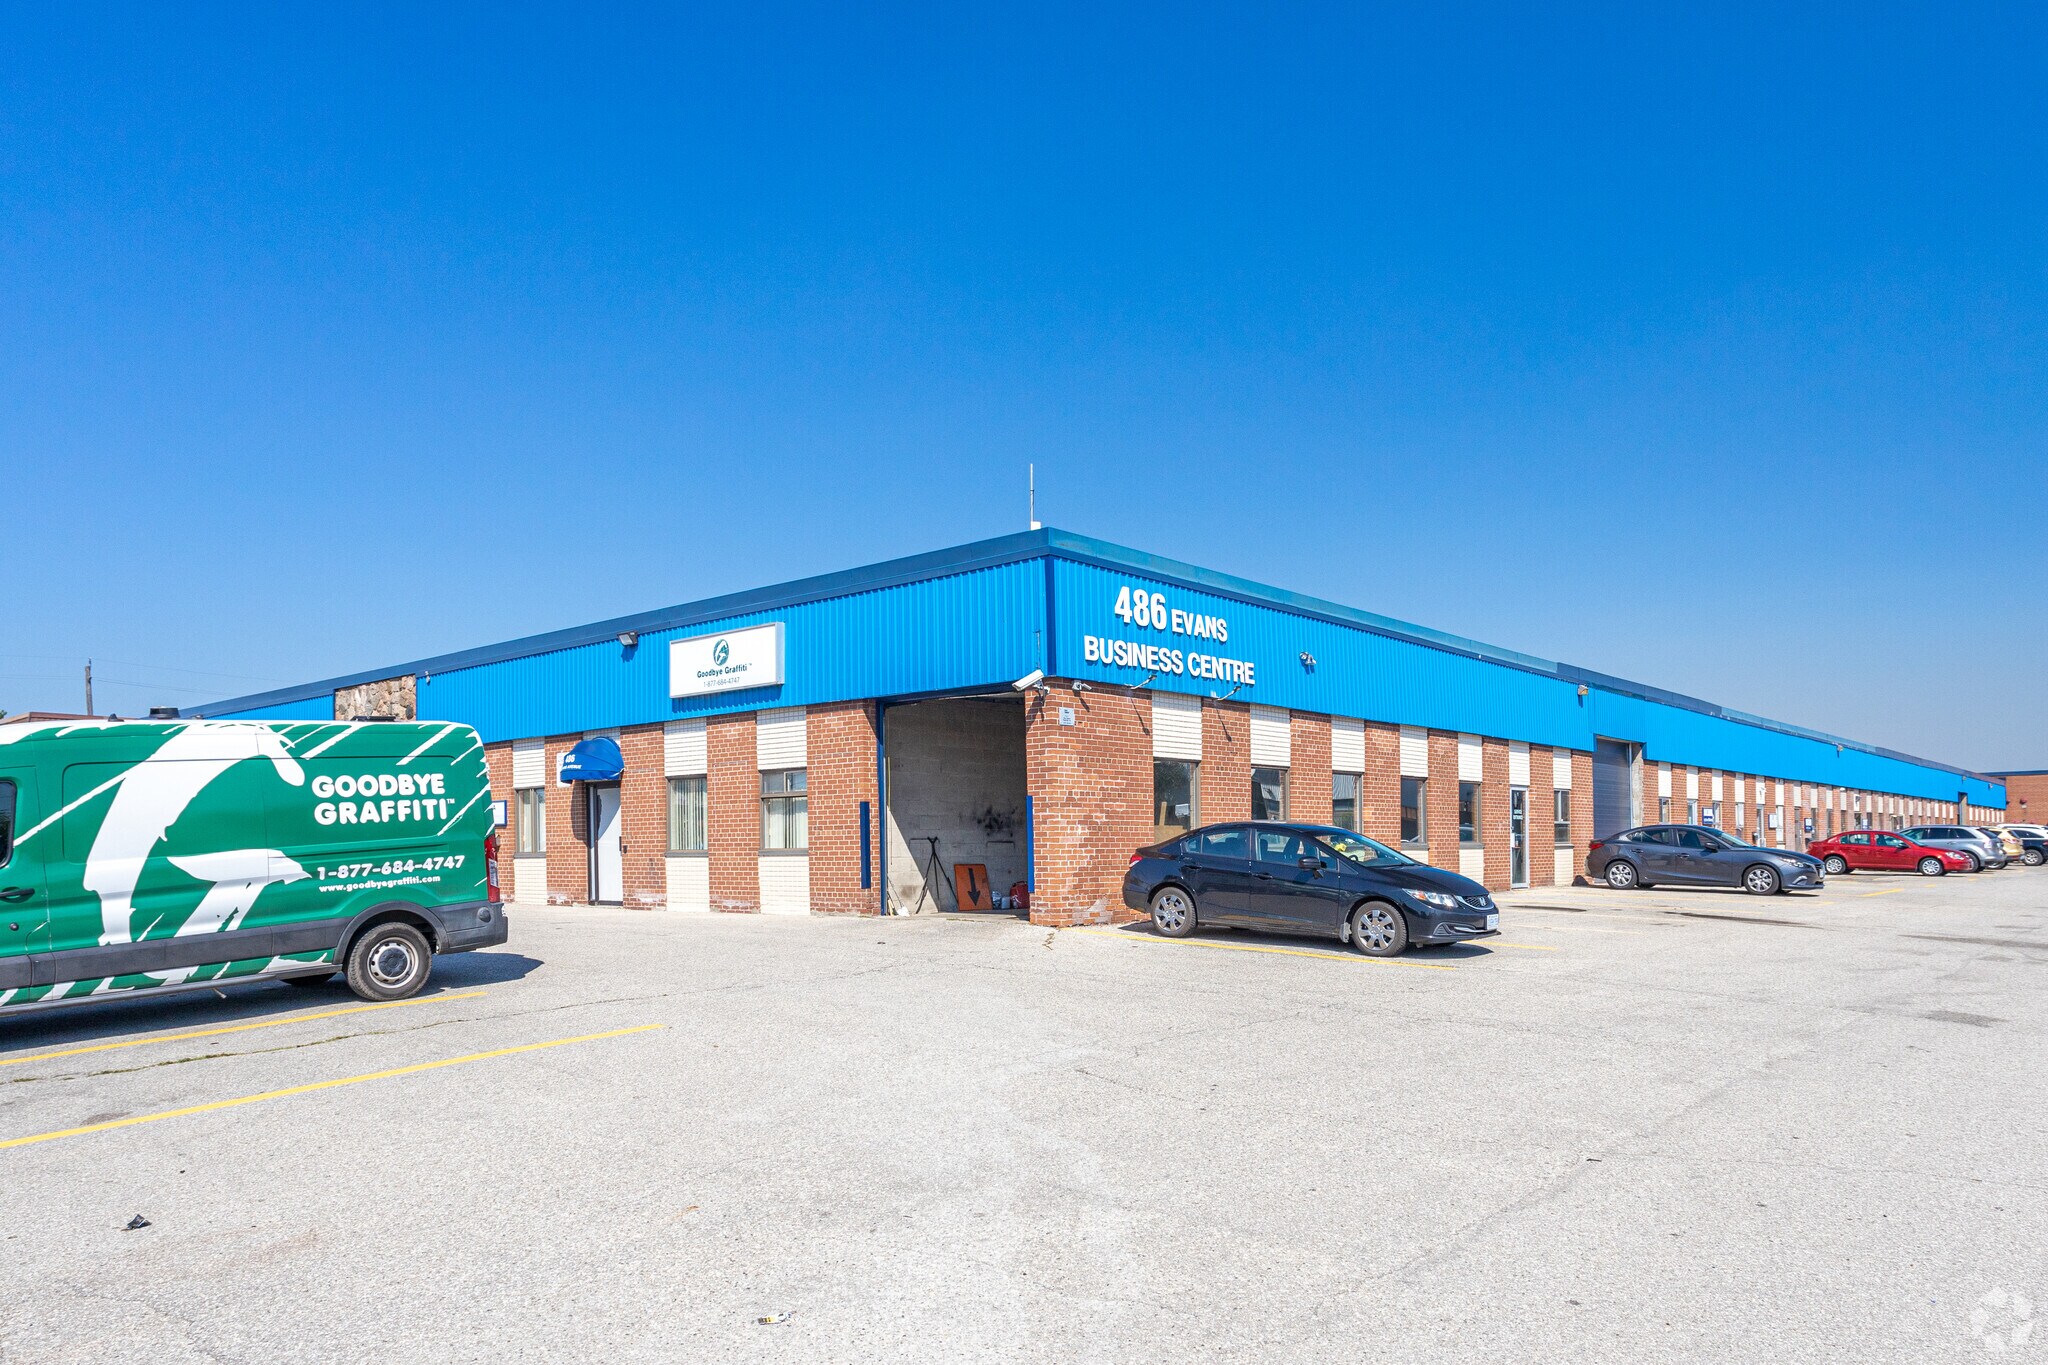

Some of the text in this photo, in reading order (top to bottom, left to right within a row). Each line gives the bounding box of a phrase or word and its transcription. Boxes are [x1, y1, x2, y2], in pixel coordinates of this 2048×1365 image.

[1114, 585, 1228, 643] 486 EVANS
[696, 669, 723, 678] Goodbye
[724, 664, 748, 674] Graffiti
[1084, 635, 1256, 685] BUSINESS CENTRE
[703, 676, 740, 687] 1-877-684-4747
[311, 773, 446, 798] GOODBYE
[314, 798, 448, 826] GRAFFITI
[317, 855, 465, 881] 1-877-684-4747
[319, 875, 441, 893] www.goodbyegraffiti.com
